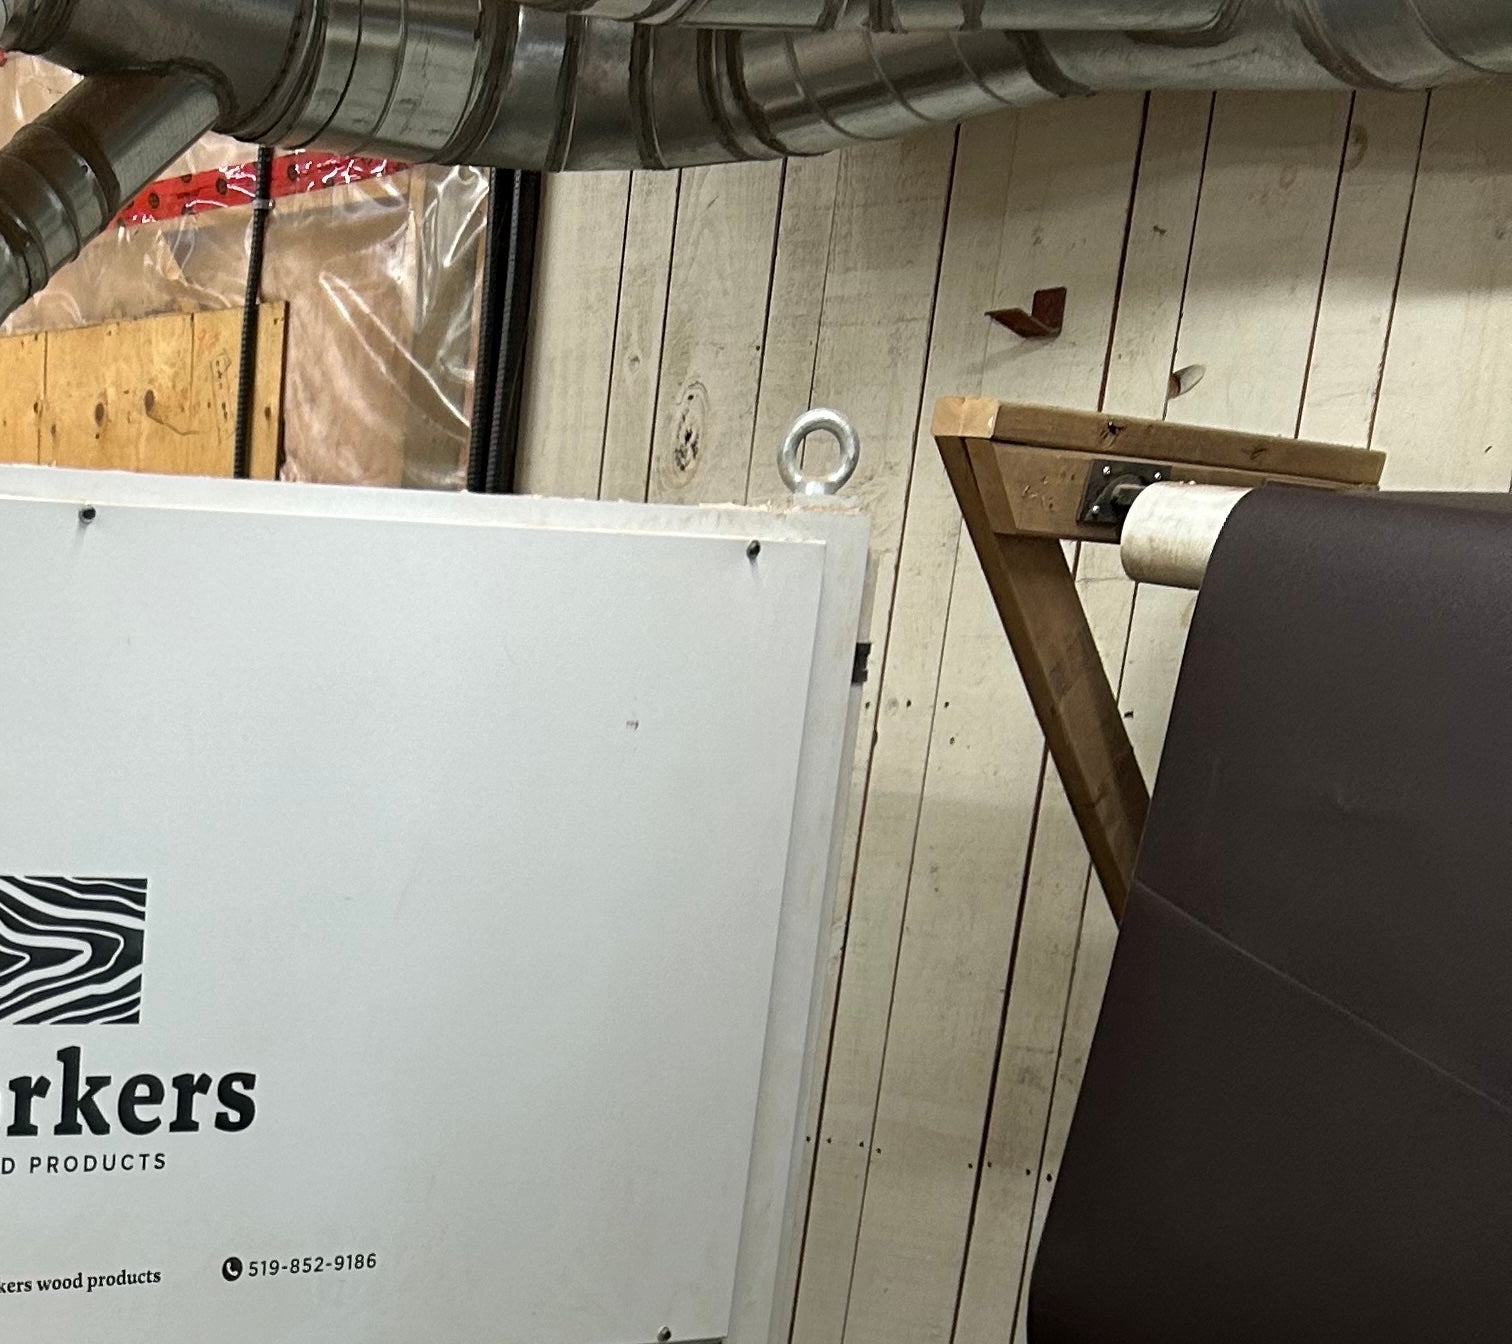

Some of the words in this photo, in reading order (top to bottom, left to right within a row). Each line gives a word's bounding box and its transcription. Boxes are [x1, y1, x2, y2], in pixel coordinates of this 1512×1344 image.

[29, 1152, 167, 1175] PRODUCTS
[248, 1252, 377, 1278] 519-852-9186
[37, 1272, 83, 1291] wood
[87, 1269, 162, 1293] products
